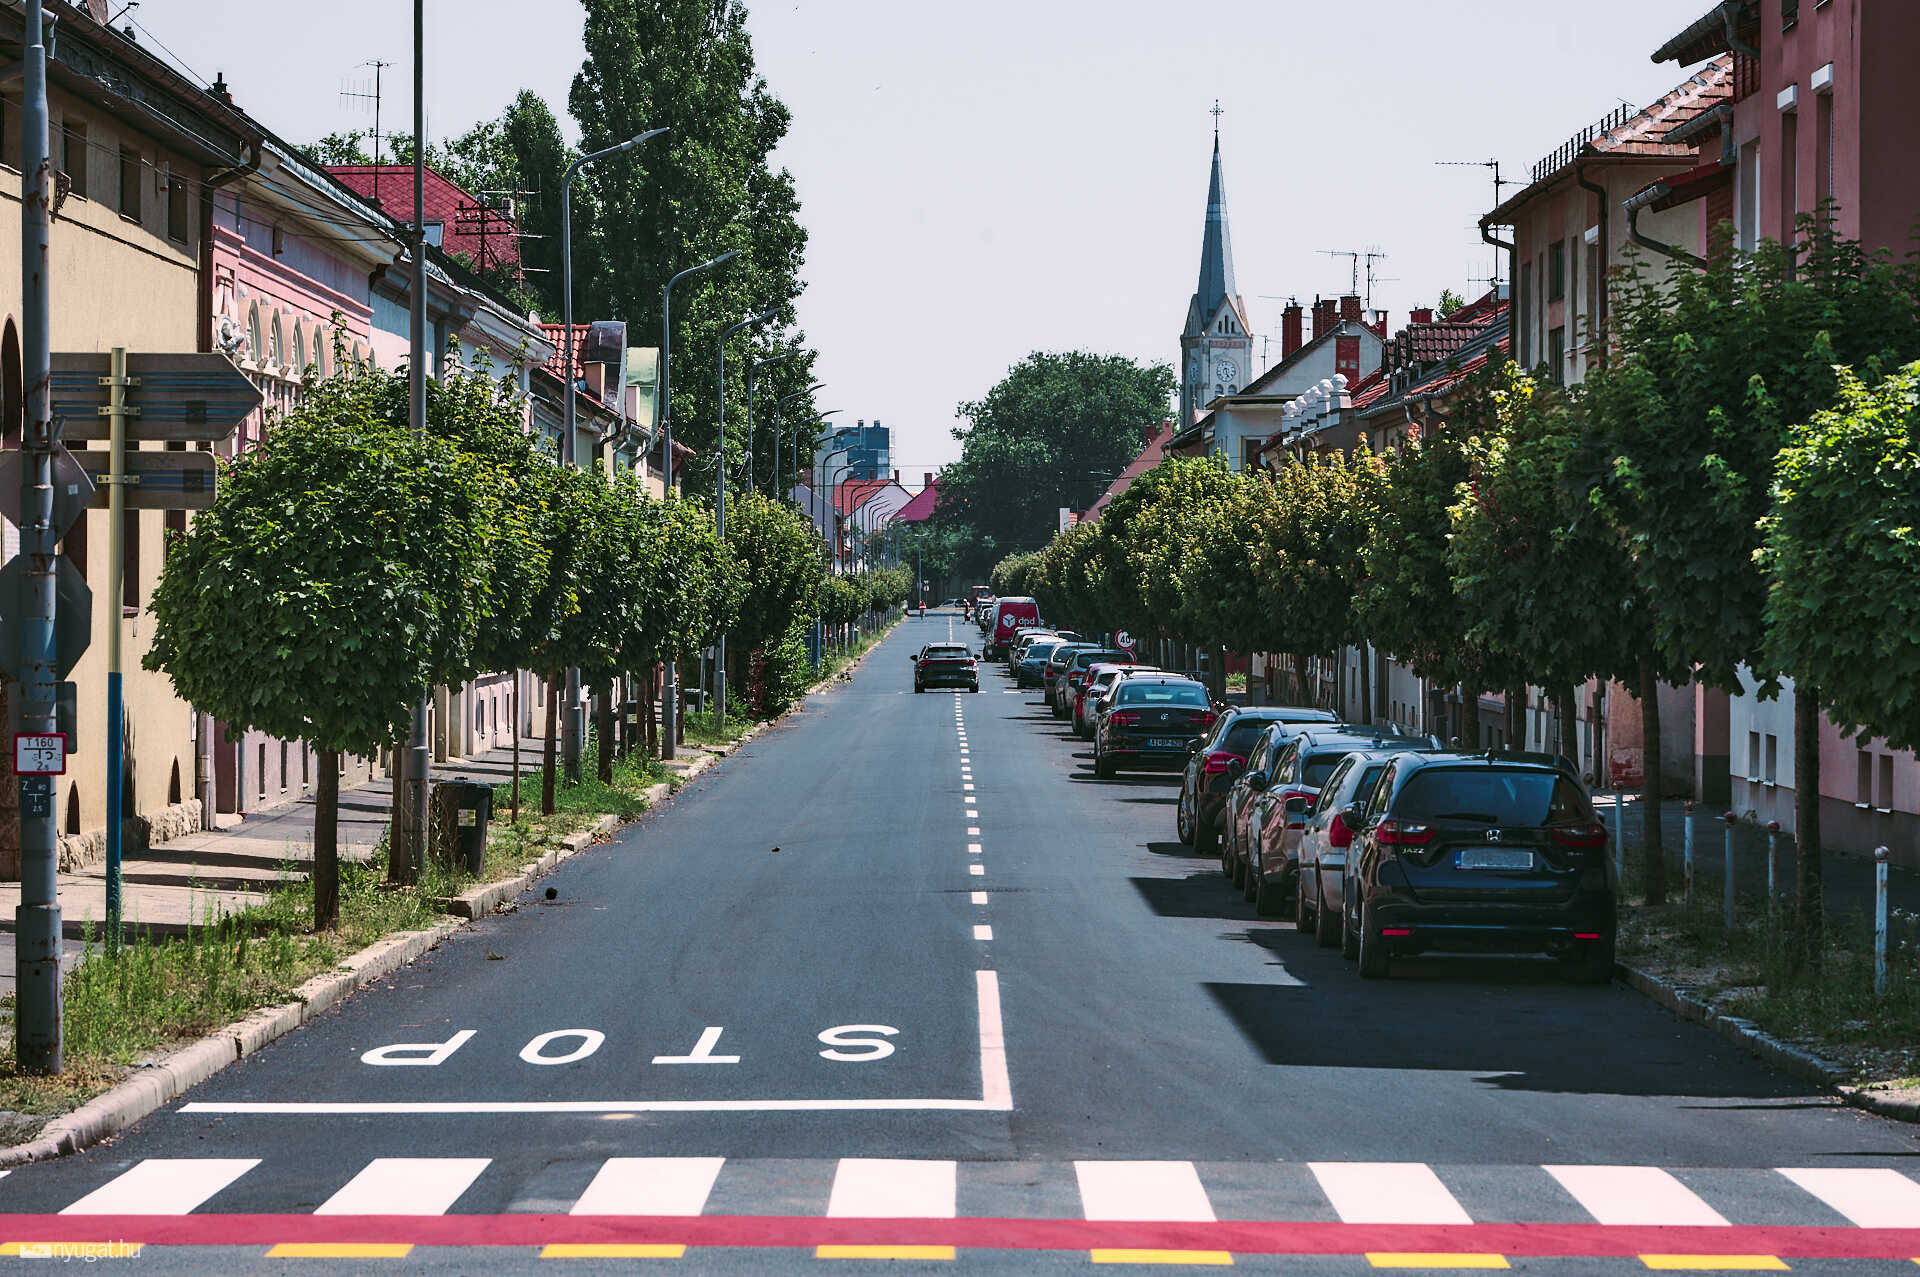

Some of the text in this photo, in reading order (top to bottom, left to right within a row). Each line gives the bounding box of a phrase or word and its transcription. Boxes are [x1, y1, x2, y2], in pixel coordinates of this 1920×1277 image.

[1018, 617, 1035, 627] dpd
[1120, 635, 1131, 644] 40
[360, 1024, 900, 1066] STOP
